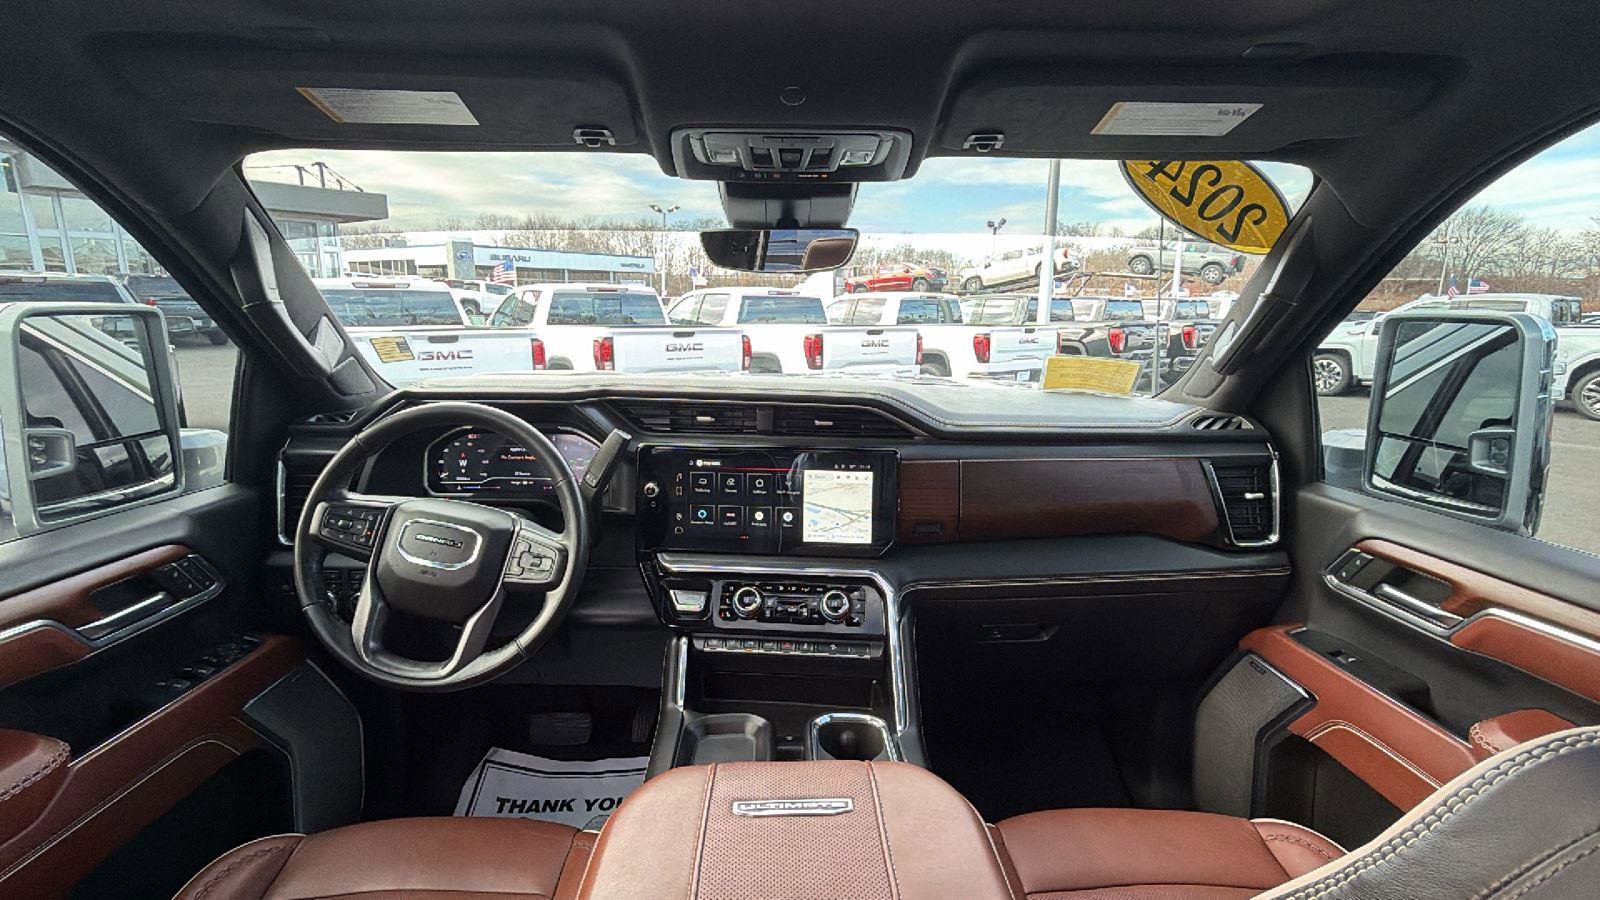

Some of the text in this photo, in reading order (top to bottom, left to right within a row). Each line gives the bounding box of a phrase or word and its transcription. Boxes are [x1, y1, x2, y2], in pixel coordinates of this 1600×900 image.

[490, 253, 531, 263] SUBARU
[664, 342, 704, 352] GMC
[861, 339, 889, 348] GMC
[417, 349, 473, 361] GMC
[496, 796, 576, 814] THANK
